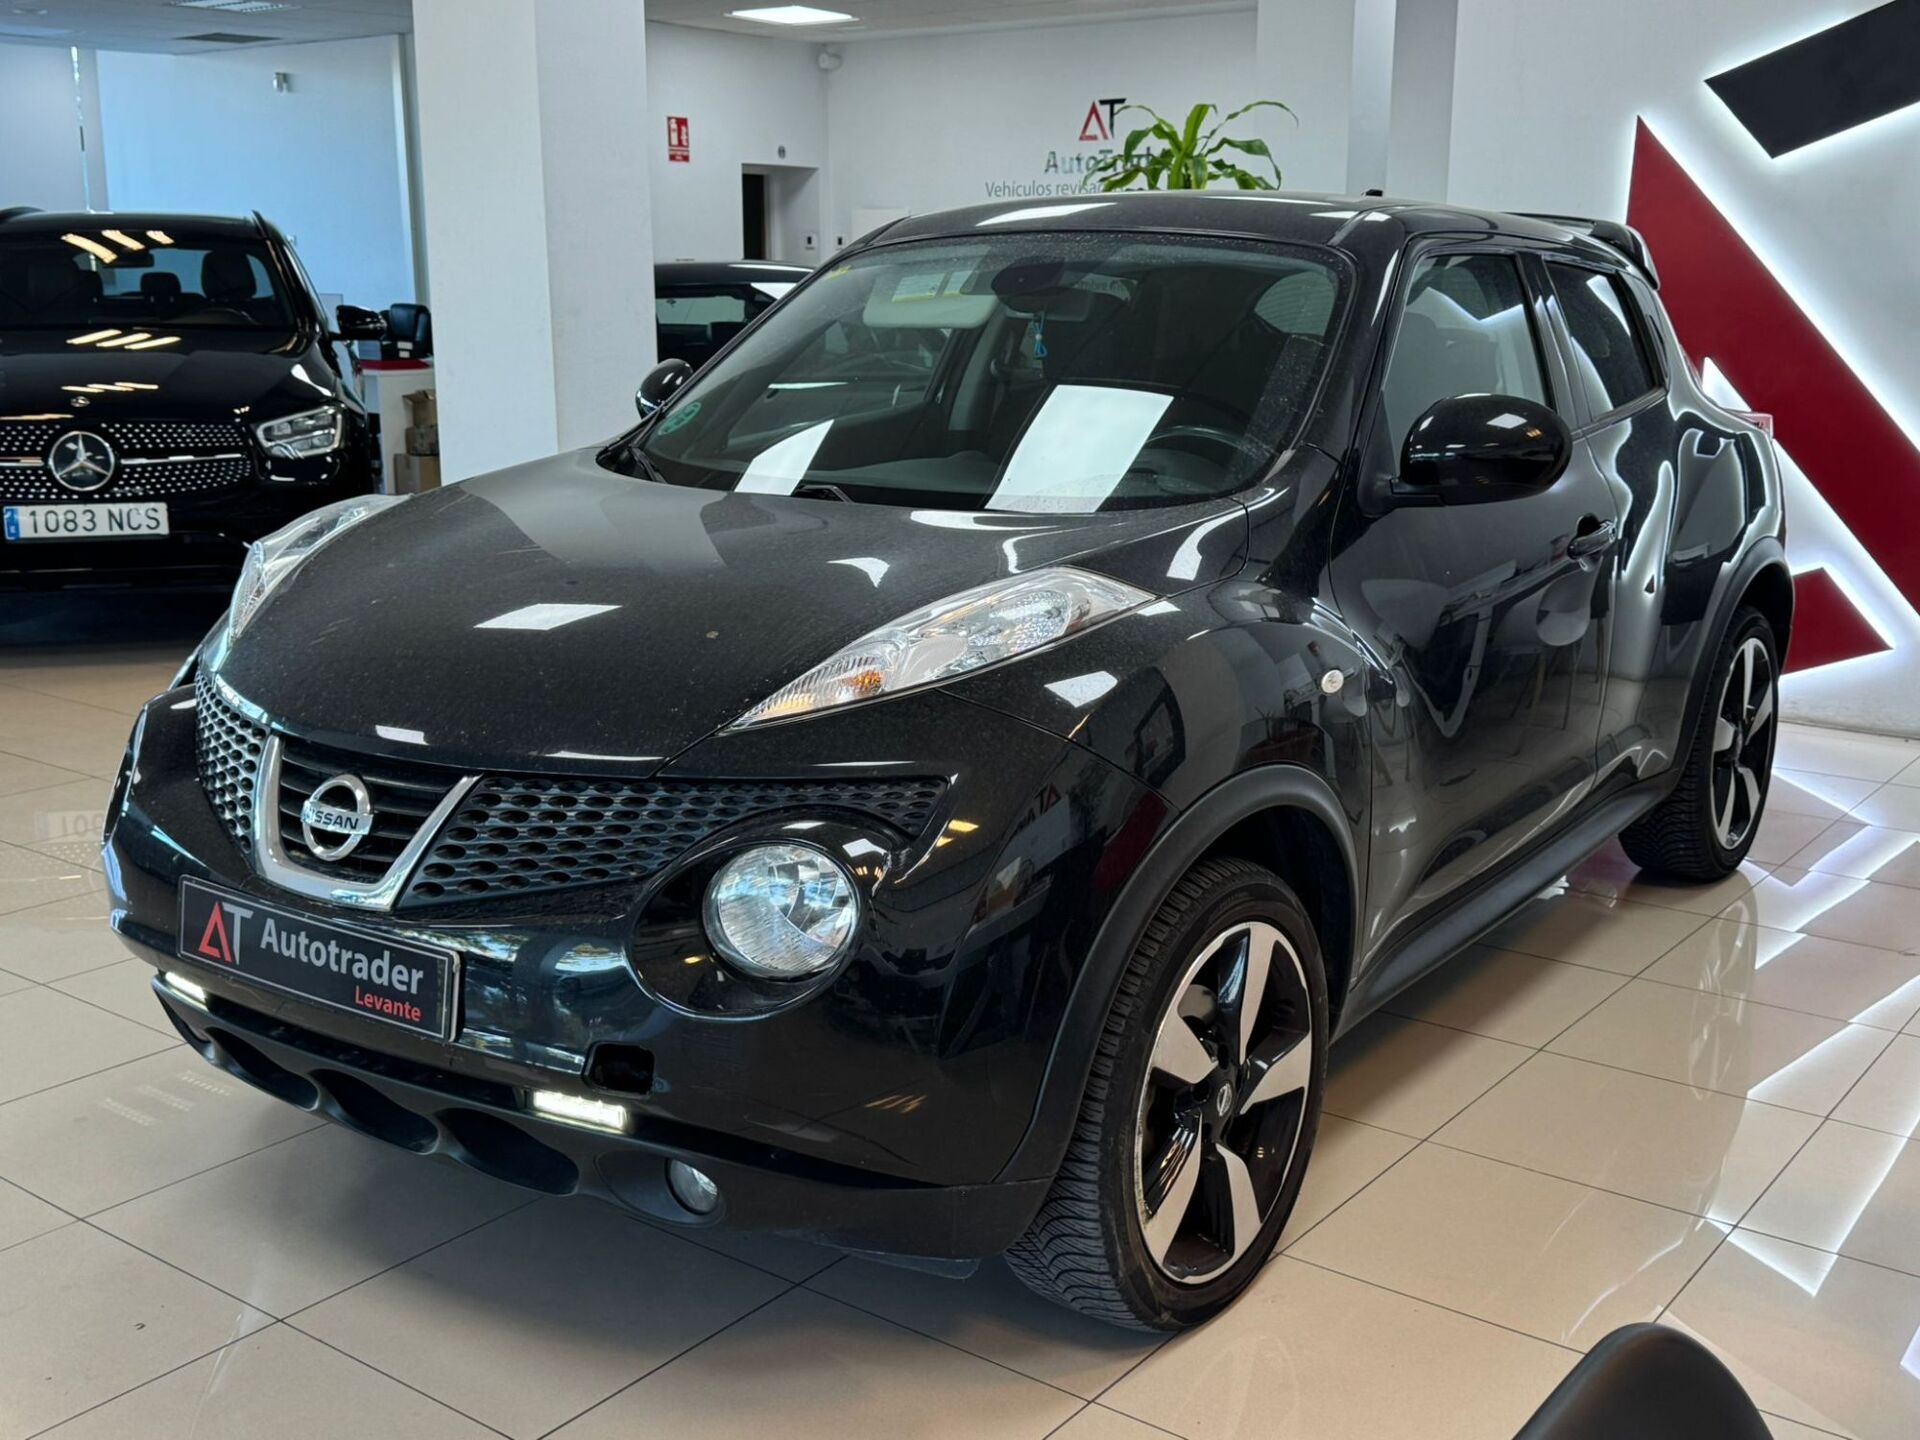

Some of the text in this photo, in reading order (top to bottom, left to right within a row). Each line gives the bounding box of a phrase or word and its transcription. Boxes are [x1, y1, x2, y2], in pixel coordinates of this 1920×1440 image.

[1078, 98, 1127, 141] AT
[29, 507, 160, 534] 1083 NCS
[260, 918, 424, 995] Autotrader
[354, 985, 422, 1023] Levante
